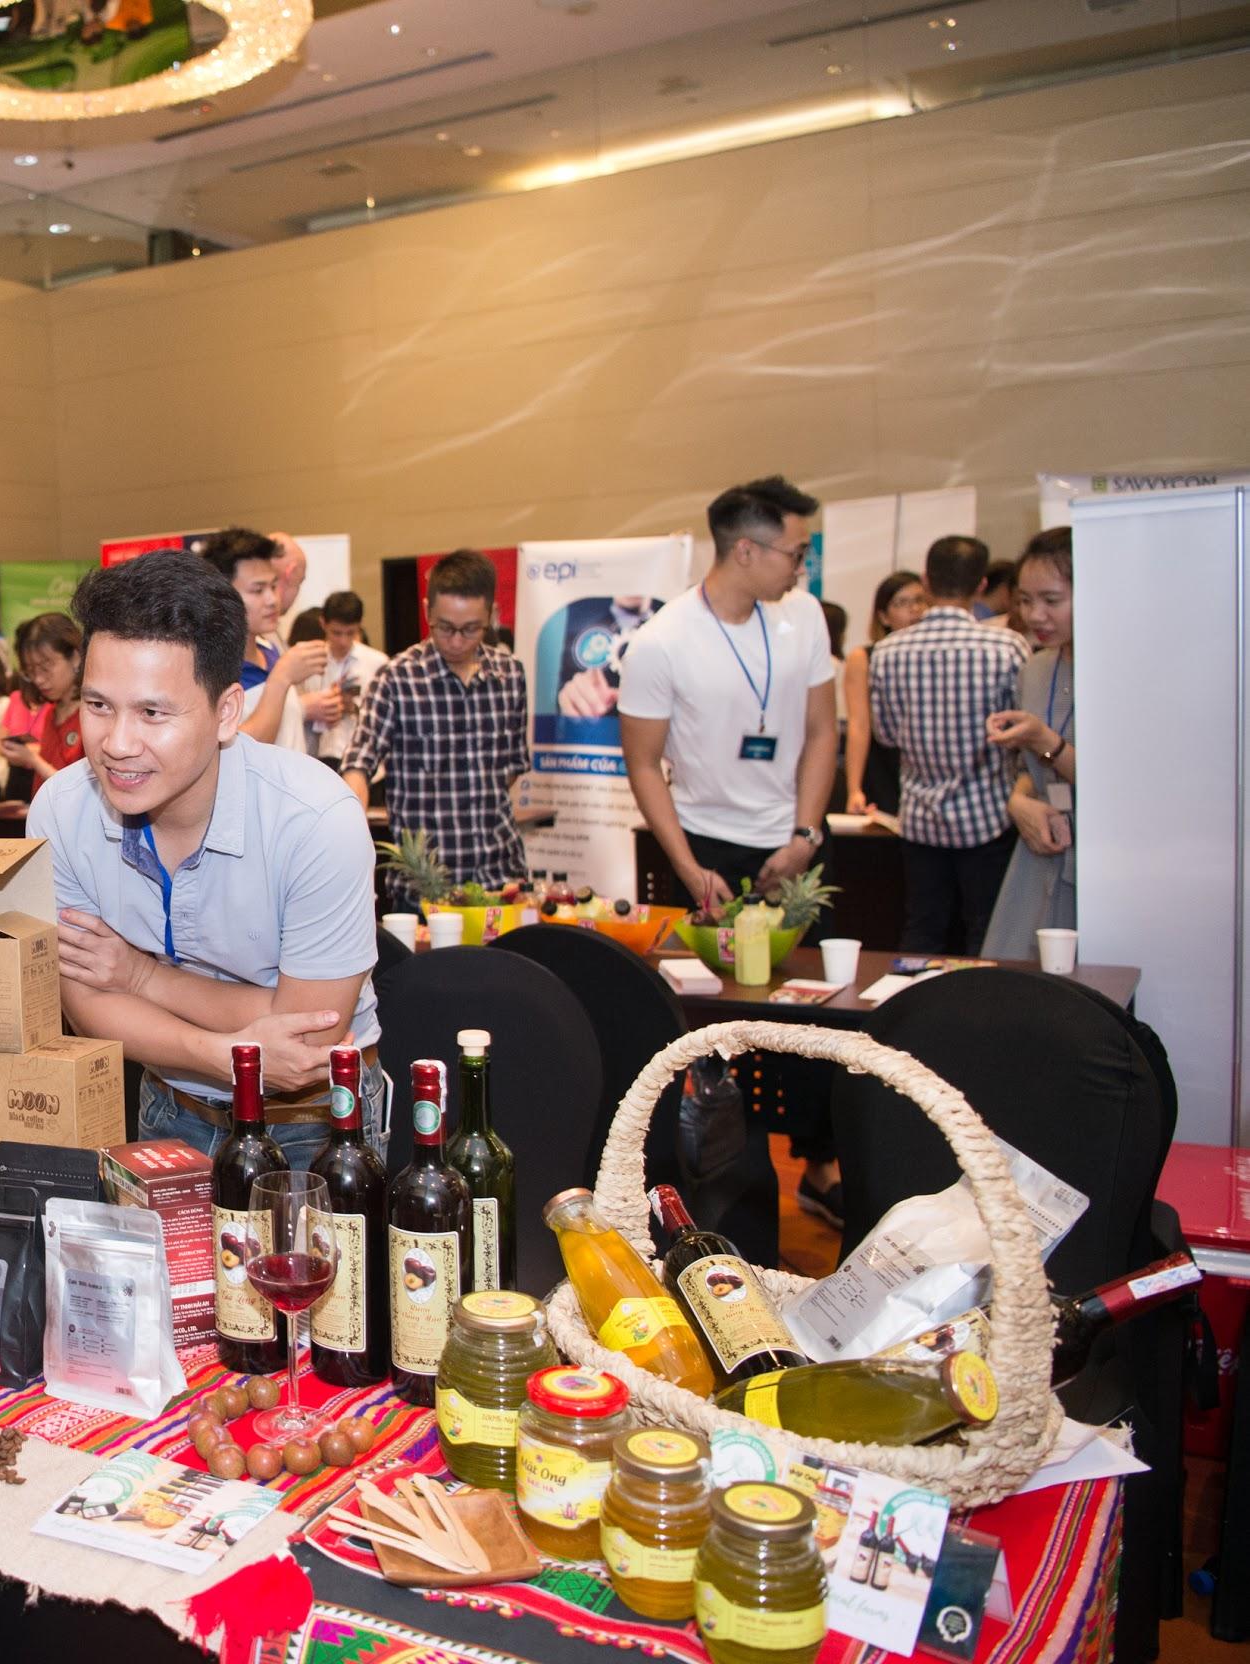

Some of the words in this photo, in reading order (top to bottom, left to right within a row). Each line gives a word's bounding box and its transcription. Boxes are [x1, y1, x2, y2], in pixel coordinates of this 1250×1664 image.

[543, 559, 577, 584] epi
[7, 1088, 60, 1115] MOON
[540, 1467, 567, 1487] Ong
